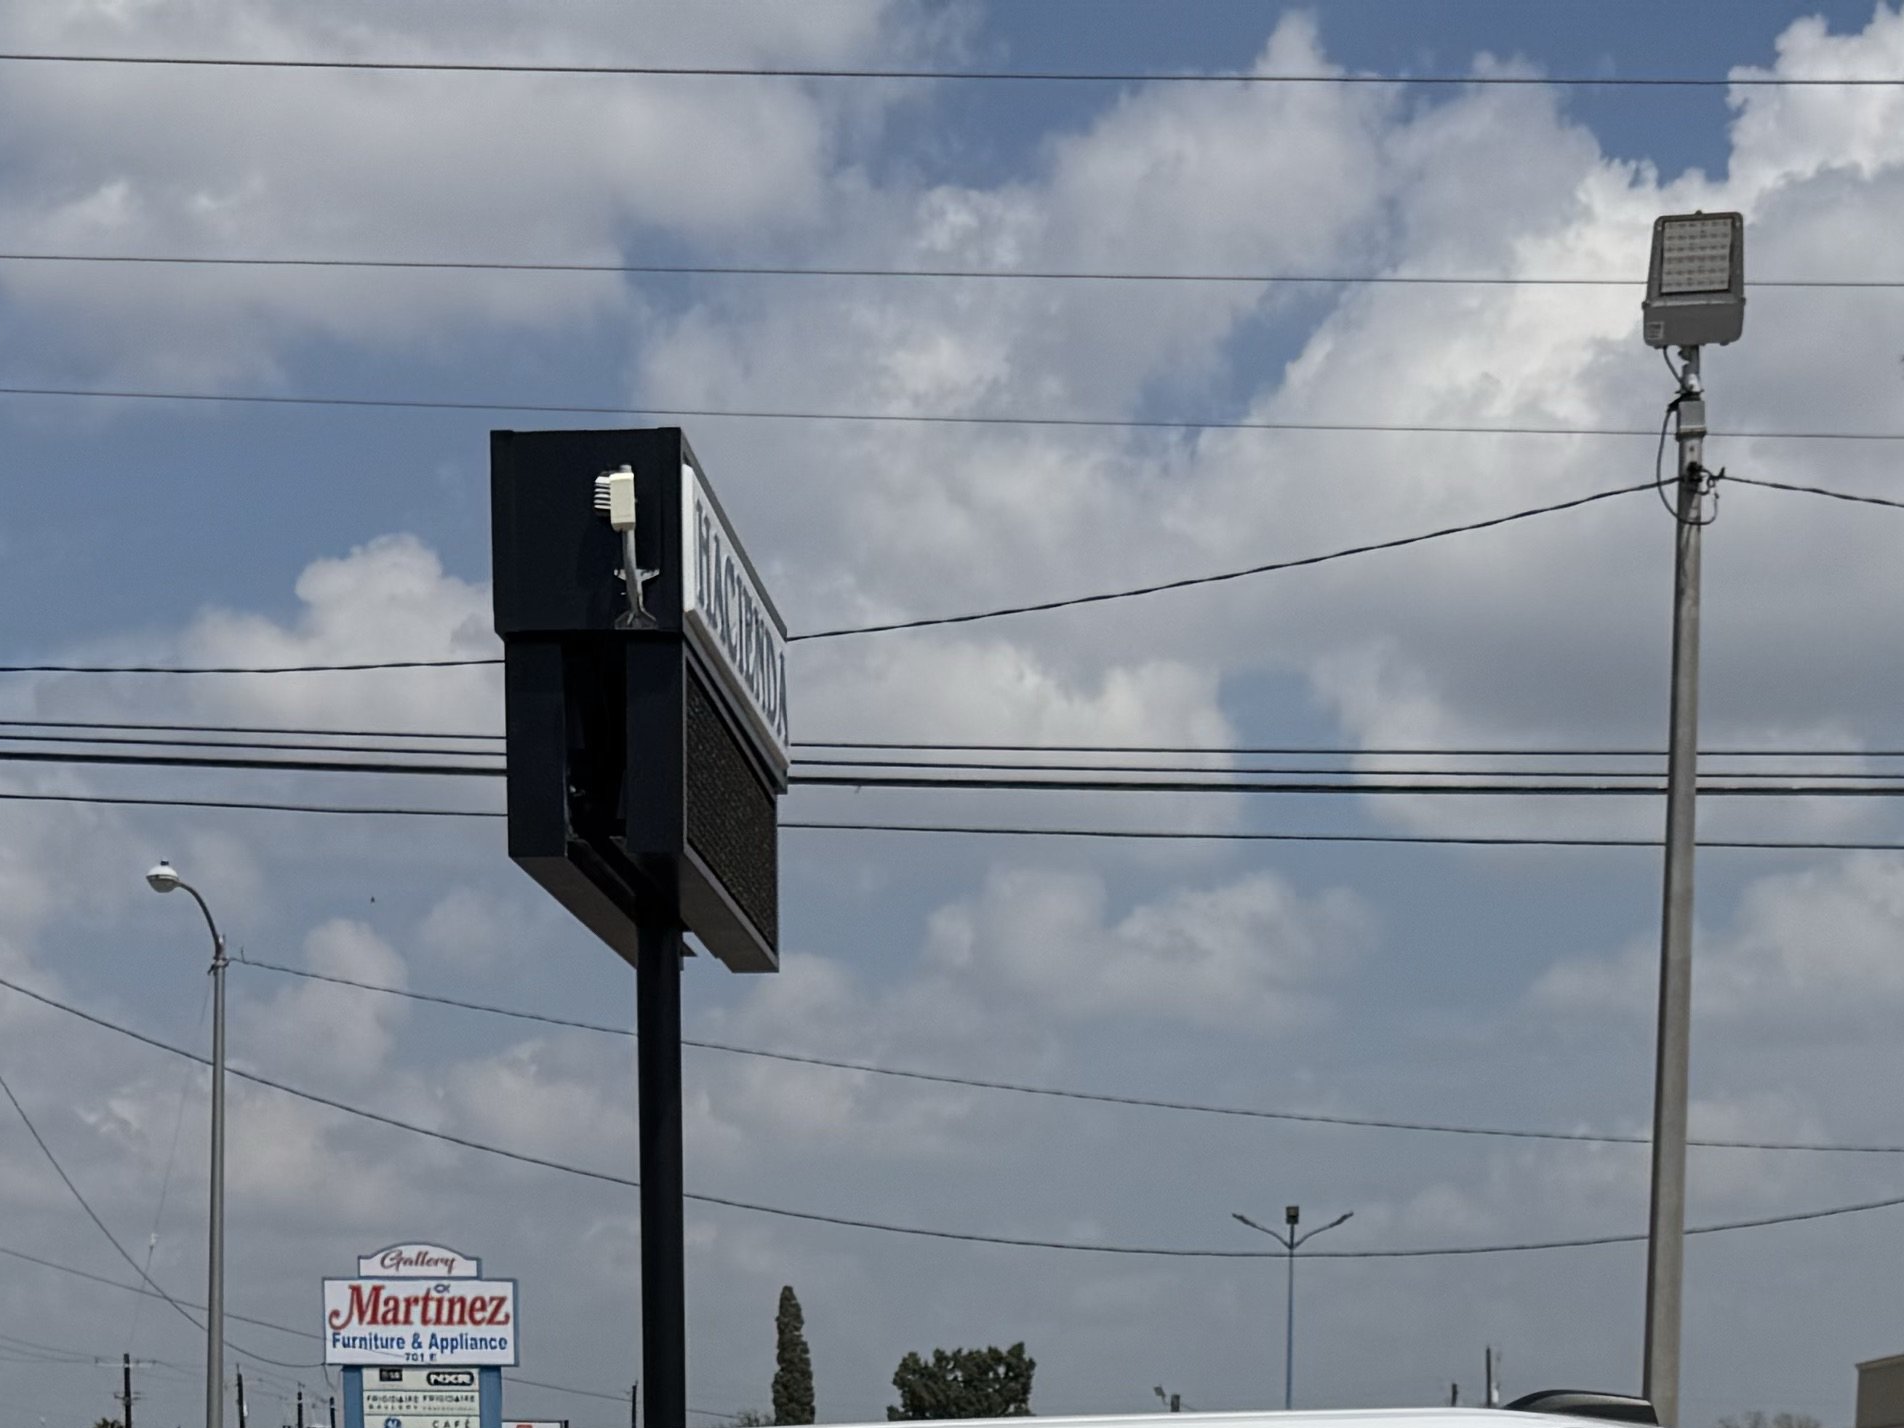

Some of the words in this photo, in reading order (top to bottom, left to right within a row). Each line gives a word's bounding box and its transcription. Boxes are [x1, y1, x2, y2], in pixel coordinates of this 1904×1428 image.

[695, 498, 790, 746] HACIENDA
[380, 1249, 456, 1275] Gallery
[328, 1283, 510, 1331] Martinez
[332, 1332, 406, 1350] Furniture
[411, 1333, 422, 1350] &
[428, 1332, 508, 1354] Appliance
[404, 1352, 425, 1362] 701
[366, 1395, 419, 1403] FRIGIDAIRE
[423, 1395, 475, 1403] FRIGIDAIRE
